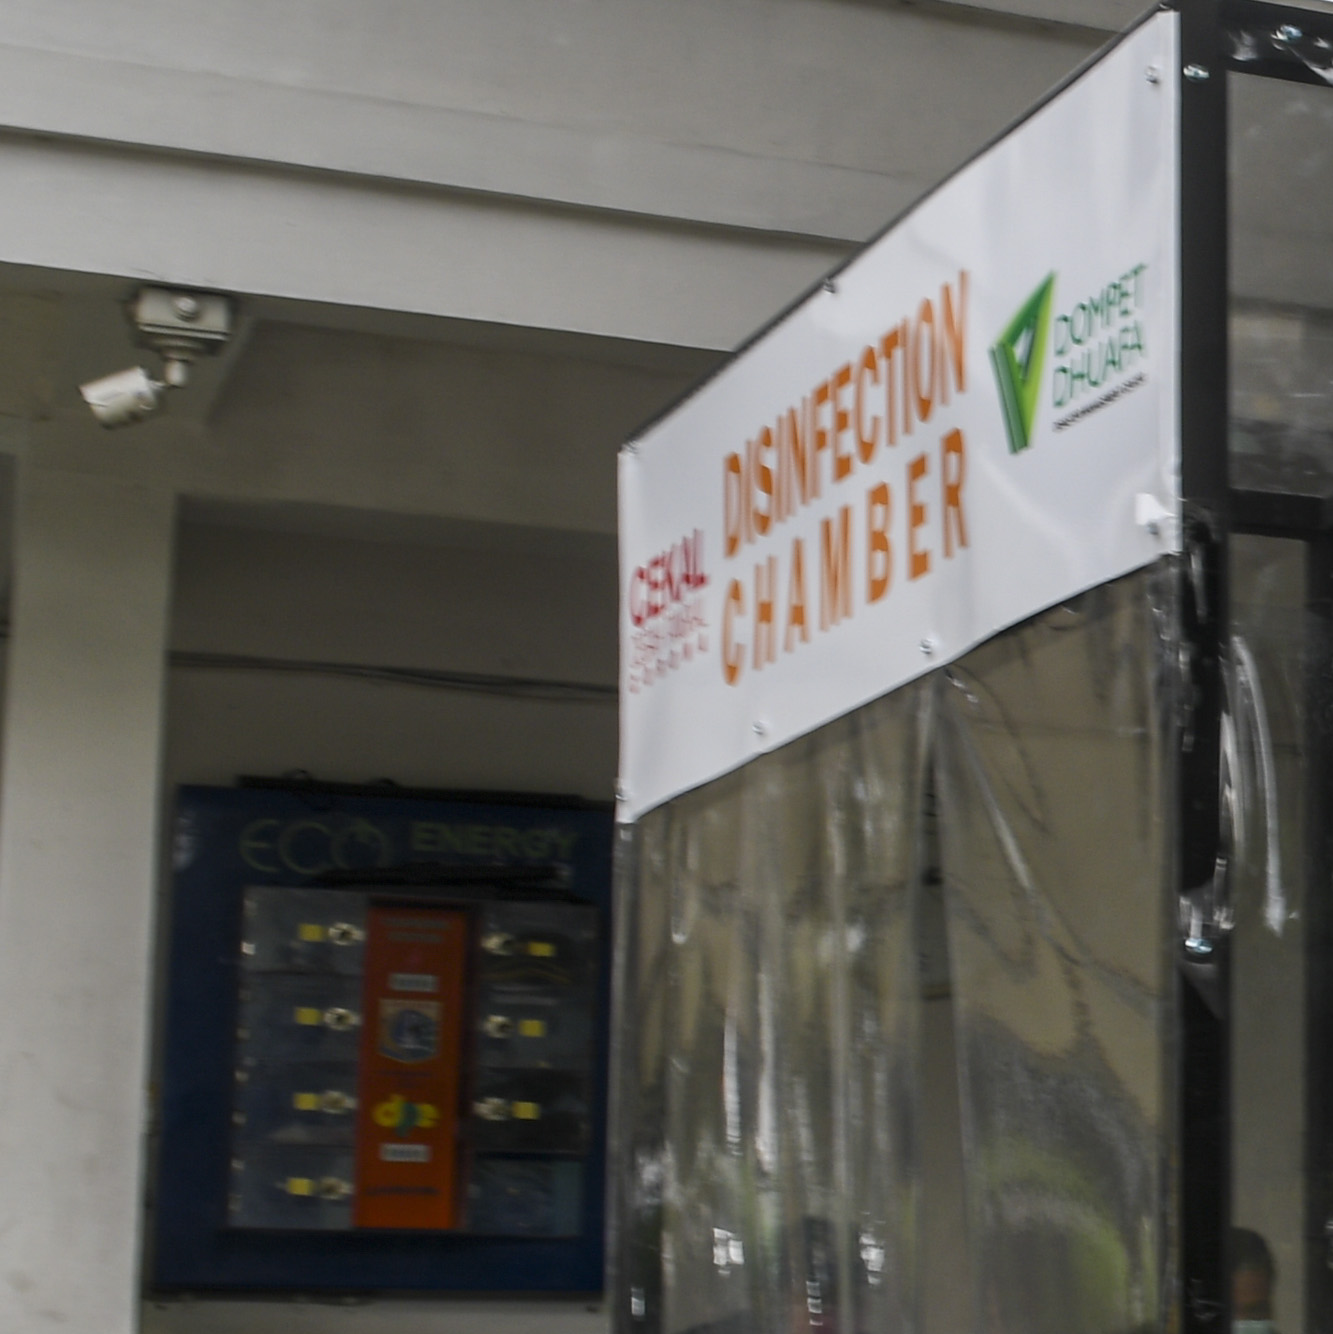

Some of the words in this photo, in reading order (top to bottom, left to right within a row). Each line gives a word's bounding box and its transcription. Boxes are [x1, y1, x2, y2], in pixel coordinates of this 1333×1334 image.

[1054, 263, 1147, 357] DOMPET
[1053, 320, 1146, 408] DHUAFA
[723, 269, 969, 559] DISINFECTION
[721, 427, 969, 687] CHAMBER
[239, 817, 389, 874] ECO
[410, 820, 578, 860] ENERGY
